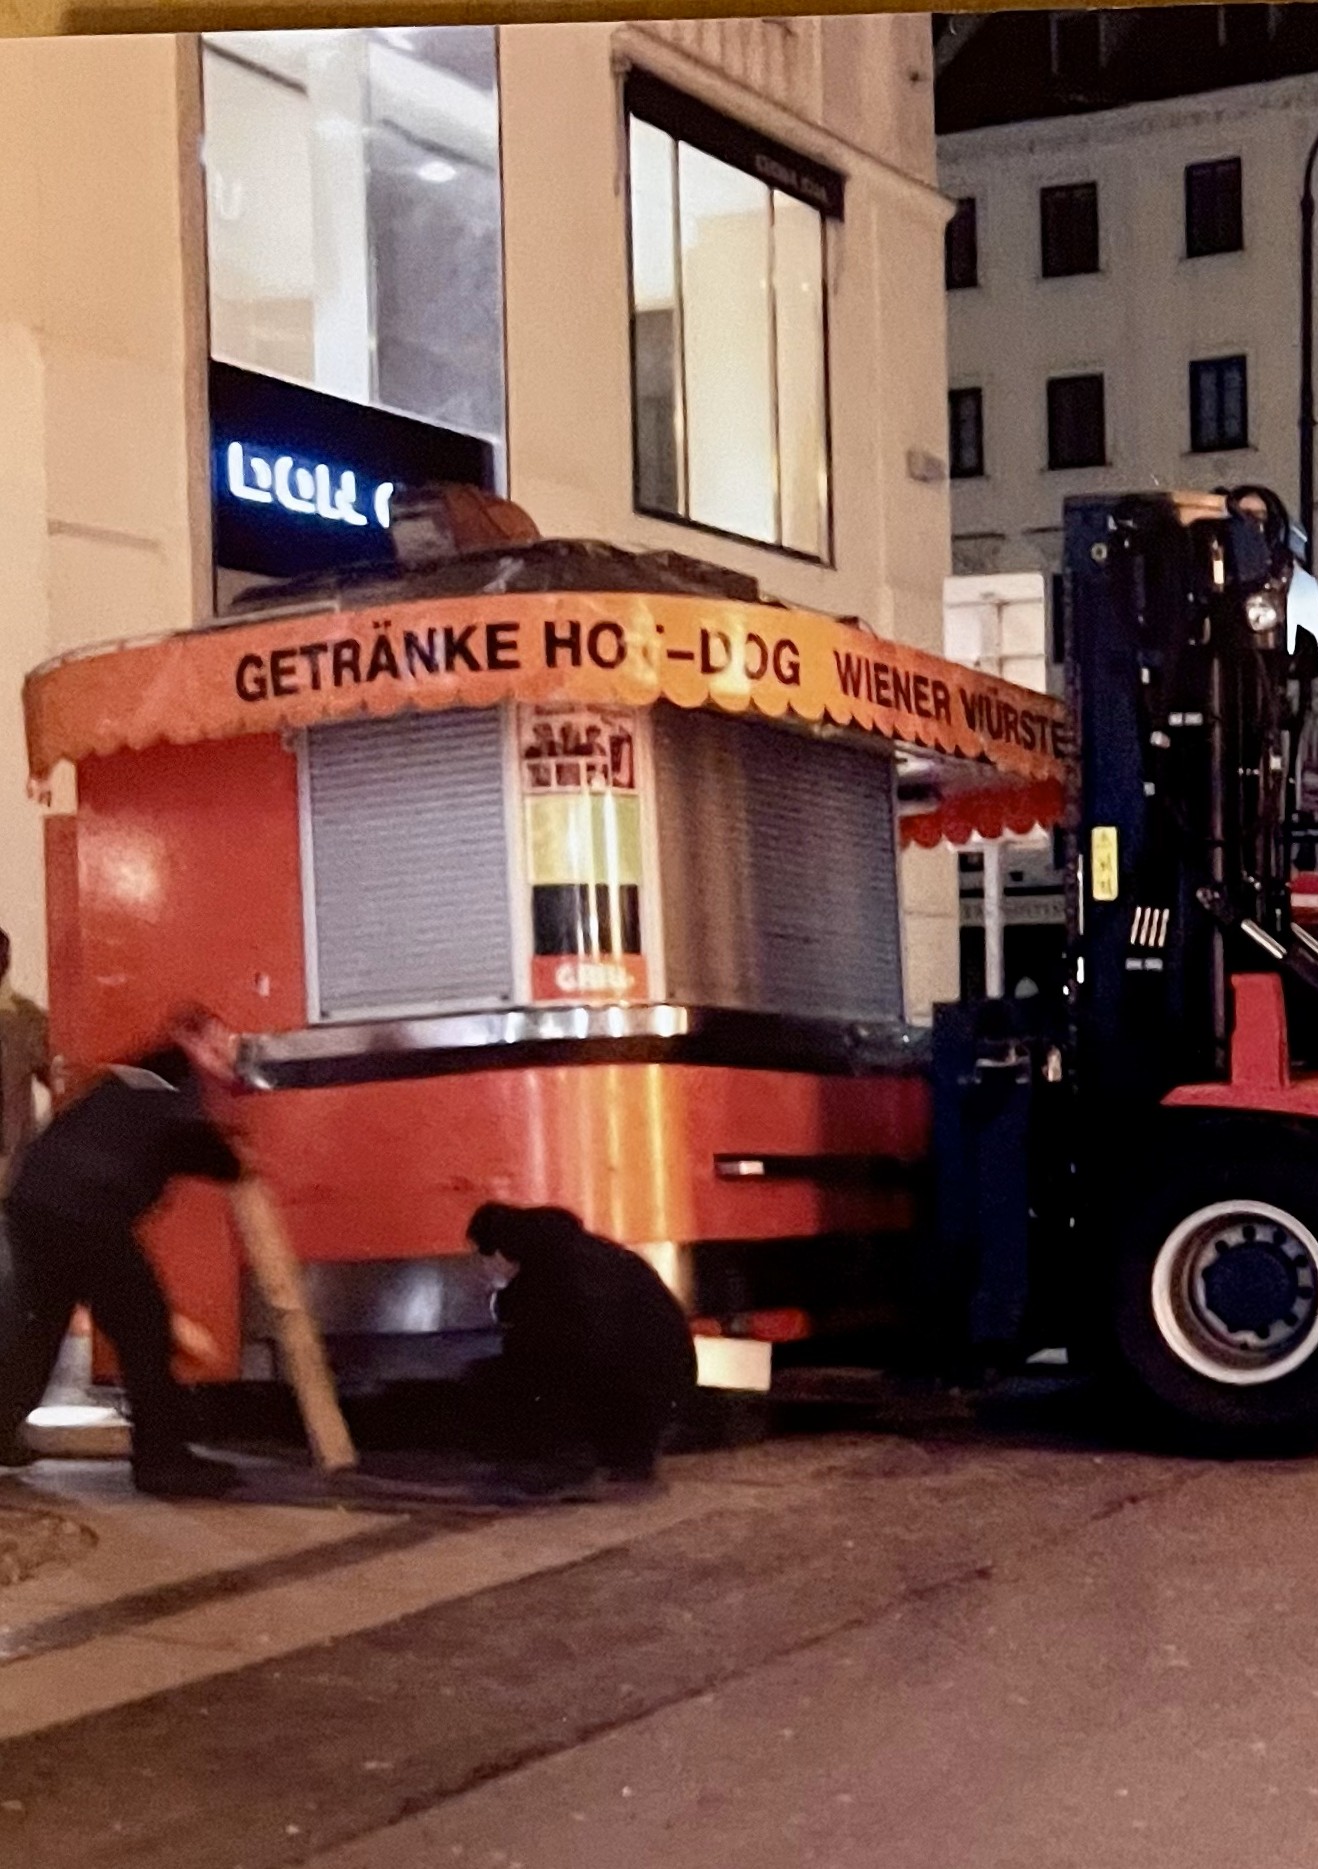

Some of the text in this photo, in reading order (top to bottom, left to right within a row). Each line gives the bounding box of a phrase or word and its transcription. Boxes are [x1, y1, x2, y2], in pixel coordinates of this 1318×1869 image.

[235, 619, 522, 702] GETRÄNKE
[543, 620, 801, 685] HO-DOG
[833, 648, 952, 726] WIENER
